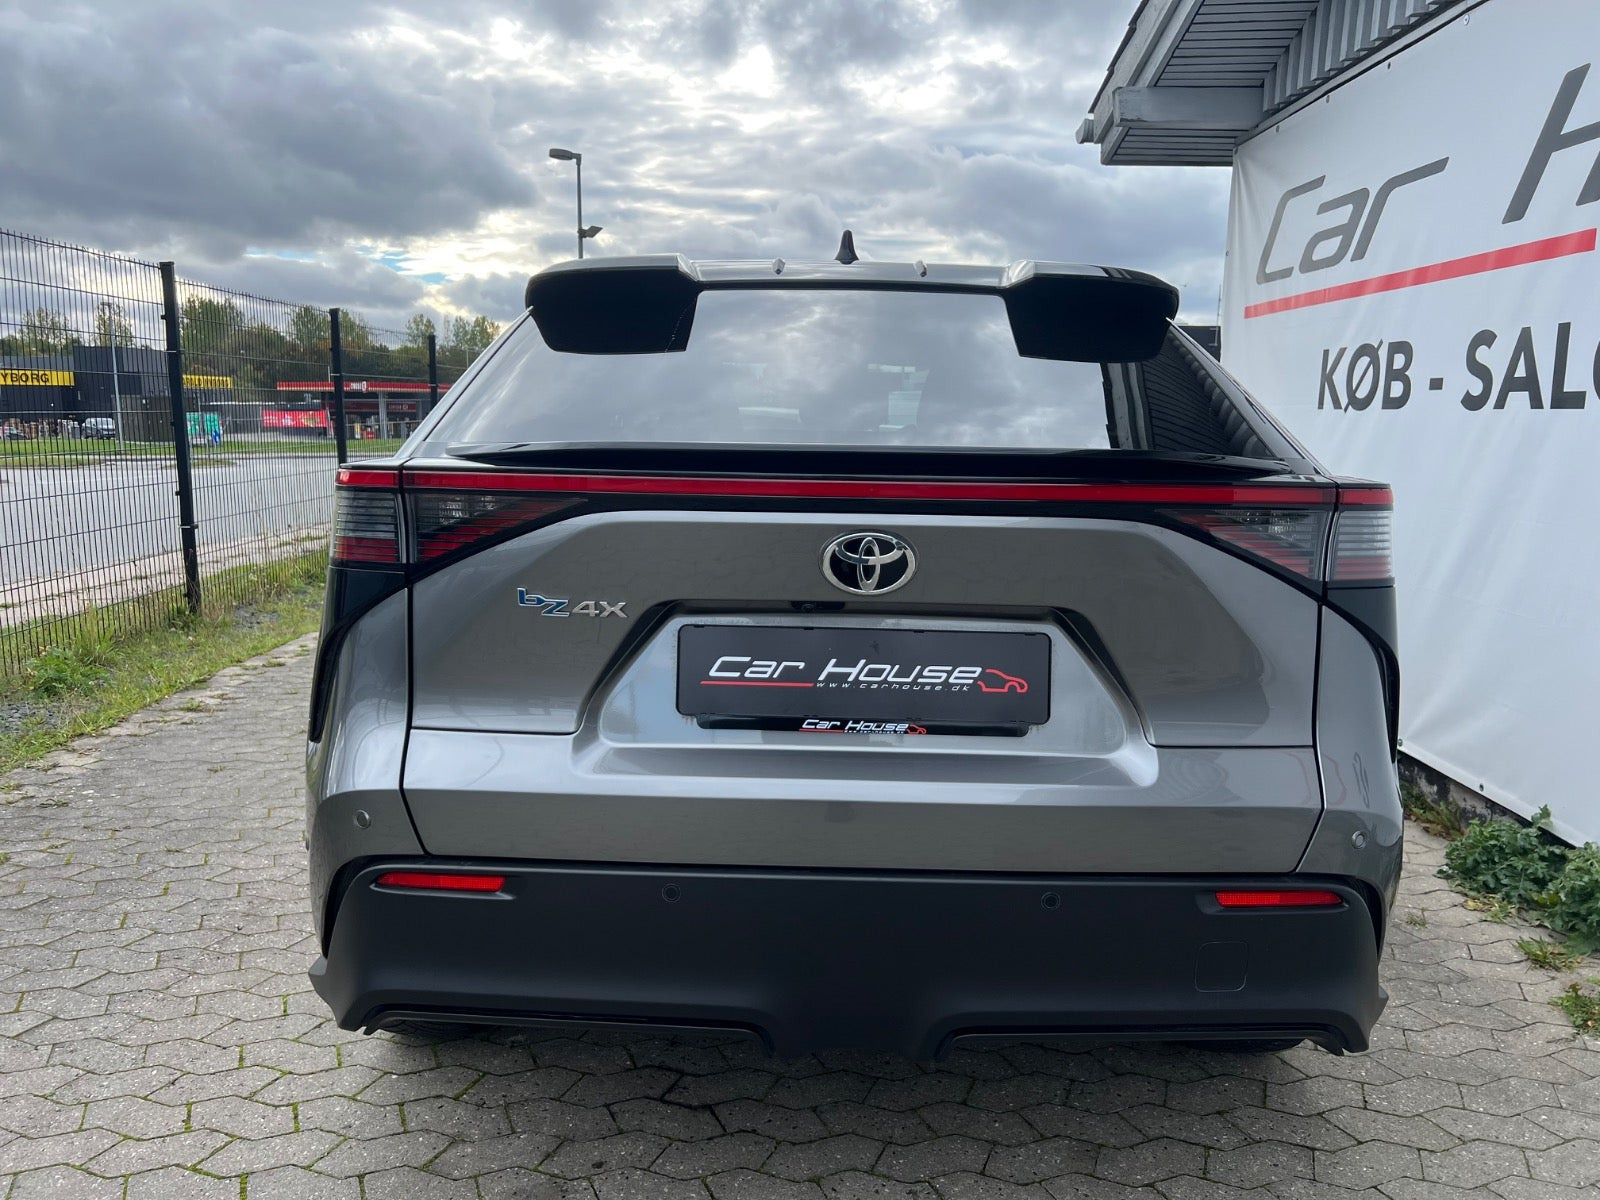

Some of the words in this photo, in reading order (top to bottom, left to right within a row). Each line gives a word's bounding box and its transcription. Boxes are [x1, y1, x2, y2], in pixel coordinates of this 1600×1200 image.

[1256, 156, 1450, 285] Car
[1317, 339, 1414, 413] KØB
[1460, 321, 1600, 412] SAL
[708, 655, 805, 679] Car
[817, 658, 982, 684] House
[816, 681, 970, 692] www.carhouse.dk
[802, 719, 840, 729] Car
[844, 720, 908, 731] House
